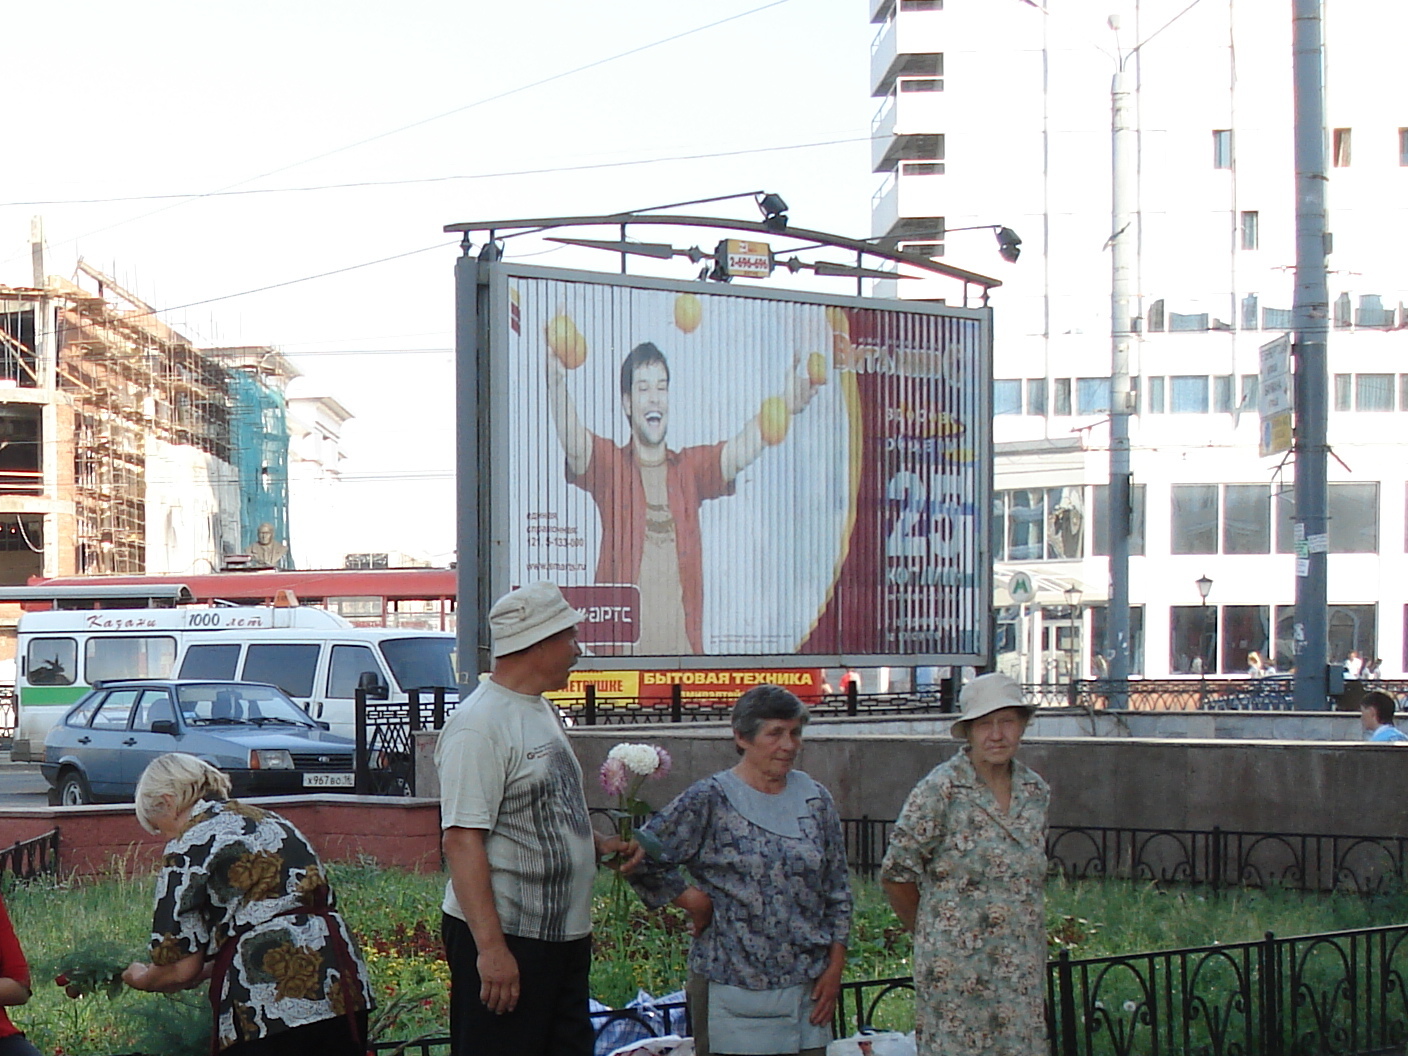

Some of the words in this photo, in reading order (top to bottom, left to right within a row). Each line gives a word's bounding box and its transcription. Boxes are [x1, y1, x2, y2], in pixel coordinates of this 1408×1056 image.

[86, 615, 157, 629] Казани
[188, 613, 220, 627] 1000
[644, 671, 731, 685] БЫТОВАЯ
[733, 672, 812, 686] ТЕХНИКА
